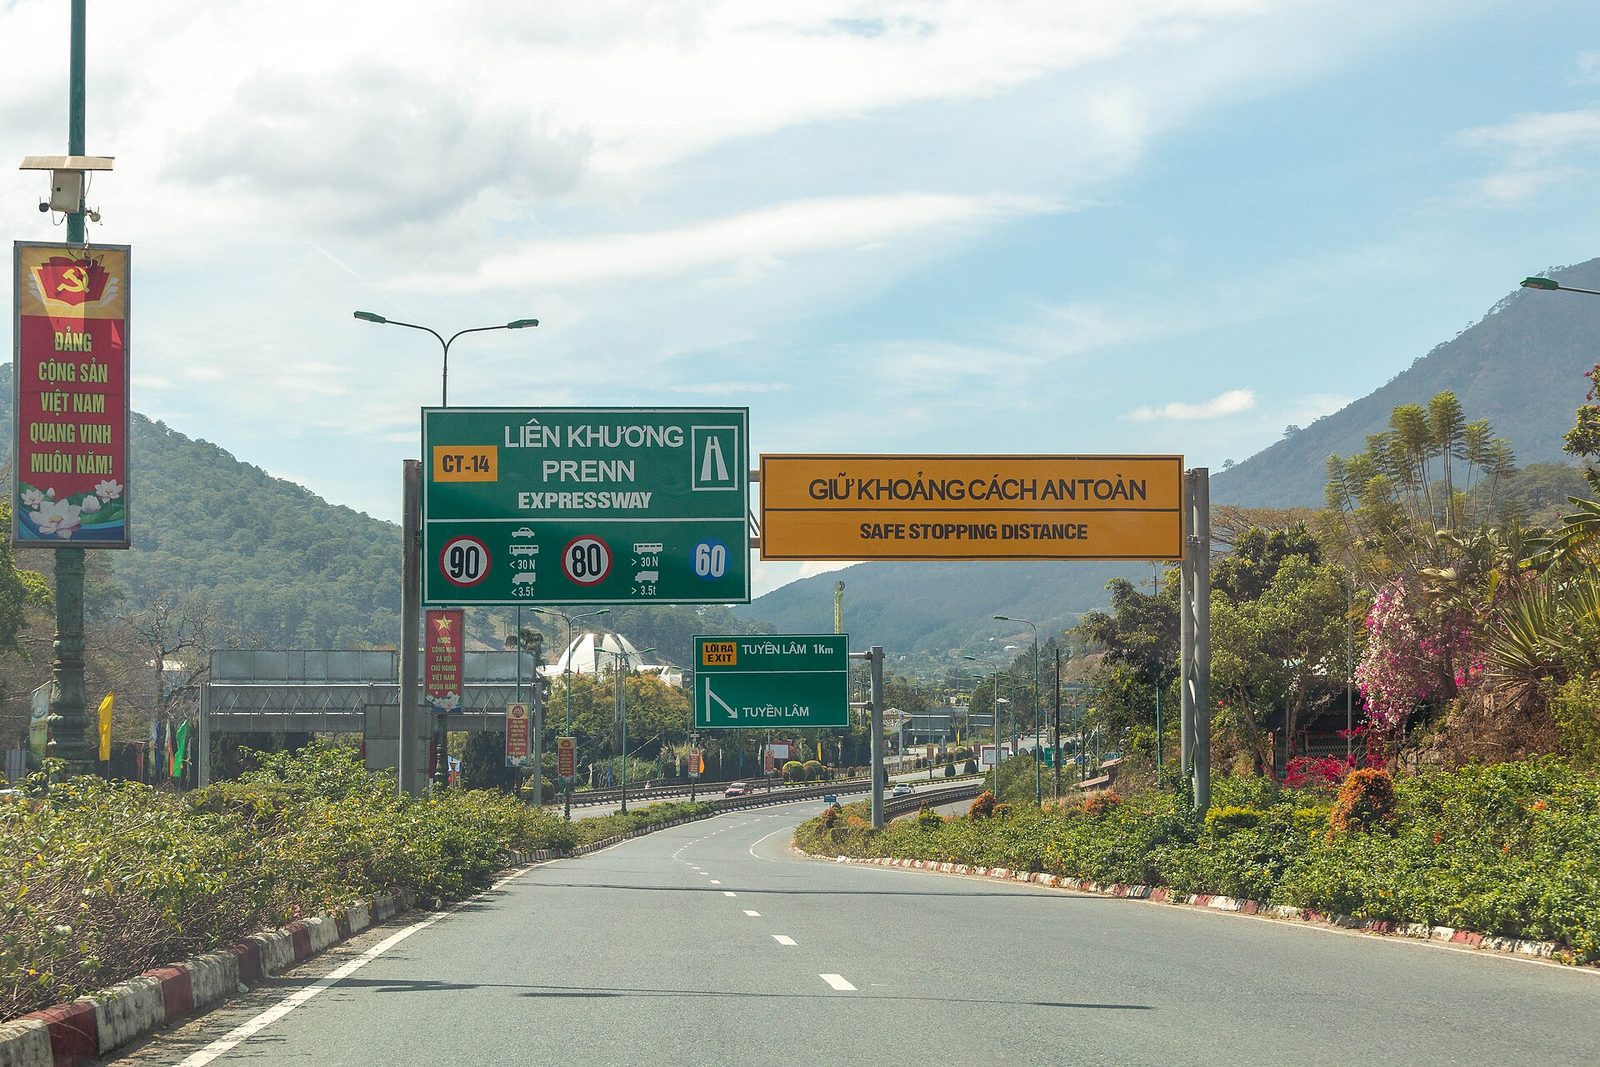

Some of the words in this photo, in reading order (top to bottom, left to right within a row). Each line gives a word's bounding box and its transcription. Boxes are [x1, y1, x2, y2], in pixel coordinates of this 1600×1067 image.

[54, 325, 92, 352] ĐẢNG
[38, 357, 76, 385] CỘNG
[79, 356, 108, 383] SẢN
[40, 388, 70, 416] VIỆT
[73, 393, 105, 414] NAM
[29, 422, 76, 444] QUANG
[79, 424, 112, 444] VINH
[504, 417, 561, 448] LIÊN
[567, 425, 684, 448] KHƯƠNG
[31, 450, 72, 473] MUÔN
[76, 451, 113, 475] NĂM!
[442, 454, 490, 473] CT-14
[542, 460, 635, 482] PRENN
[808, 471, 855, 500] GIỮ
[857, 470, 965, 500] KHOẢNG
[968, 473, 1037, 501] CÁCH
[1040, 479, 1076, 501] AN
[1077, 473, 1147, 501] TOÀN
[518, 491, 652, 509] EXPRESSWAY
[859, 523, 905, 540] SAFE
[908, 523, 997, 540] STOPPING
[1001, 523, 1088, 540] DISTANCE
[450, 546, 480, 579] 90
[571, 543, 602, 578] 80
[695, 543, 726, 578] 60
[707, 654, 732, 663] EXIT
[721, 644, 734, 653] RA
[782, 641, 807, 655] LÂM
[813, 643, 834, 655] 1Km
[784, 703, 809, 717] LÂM
